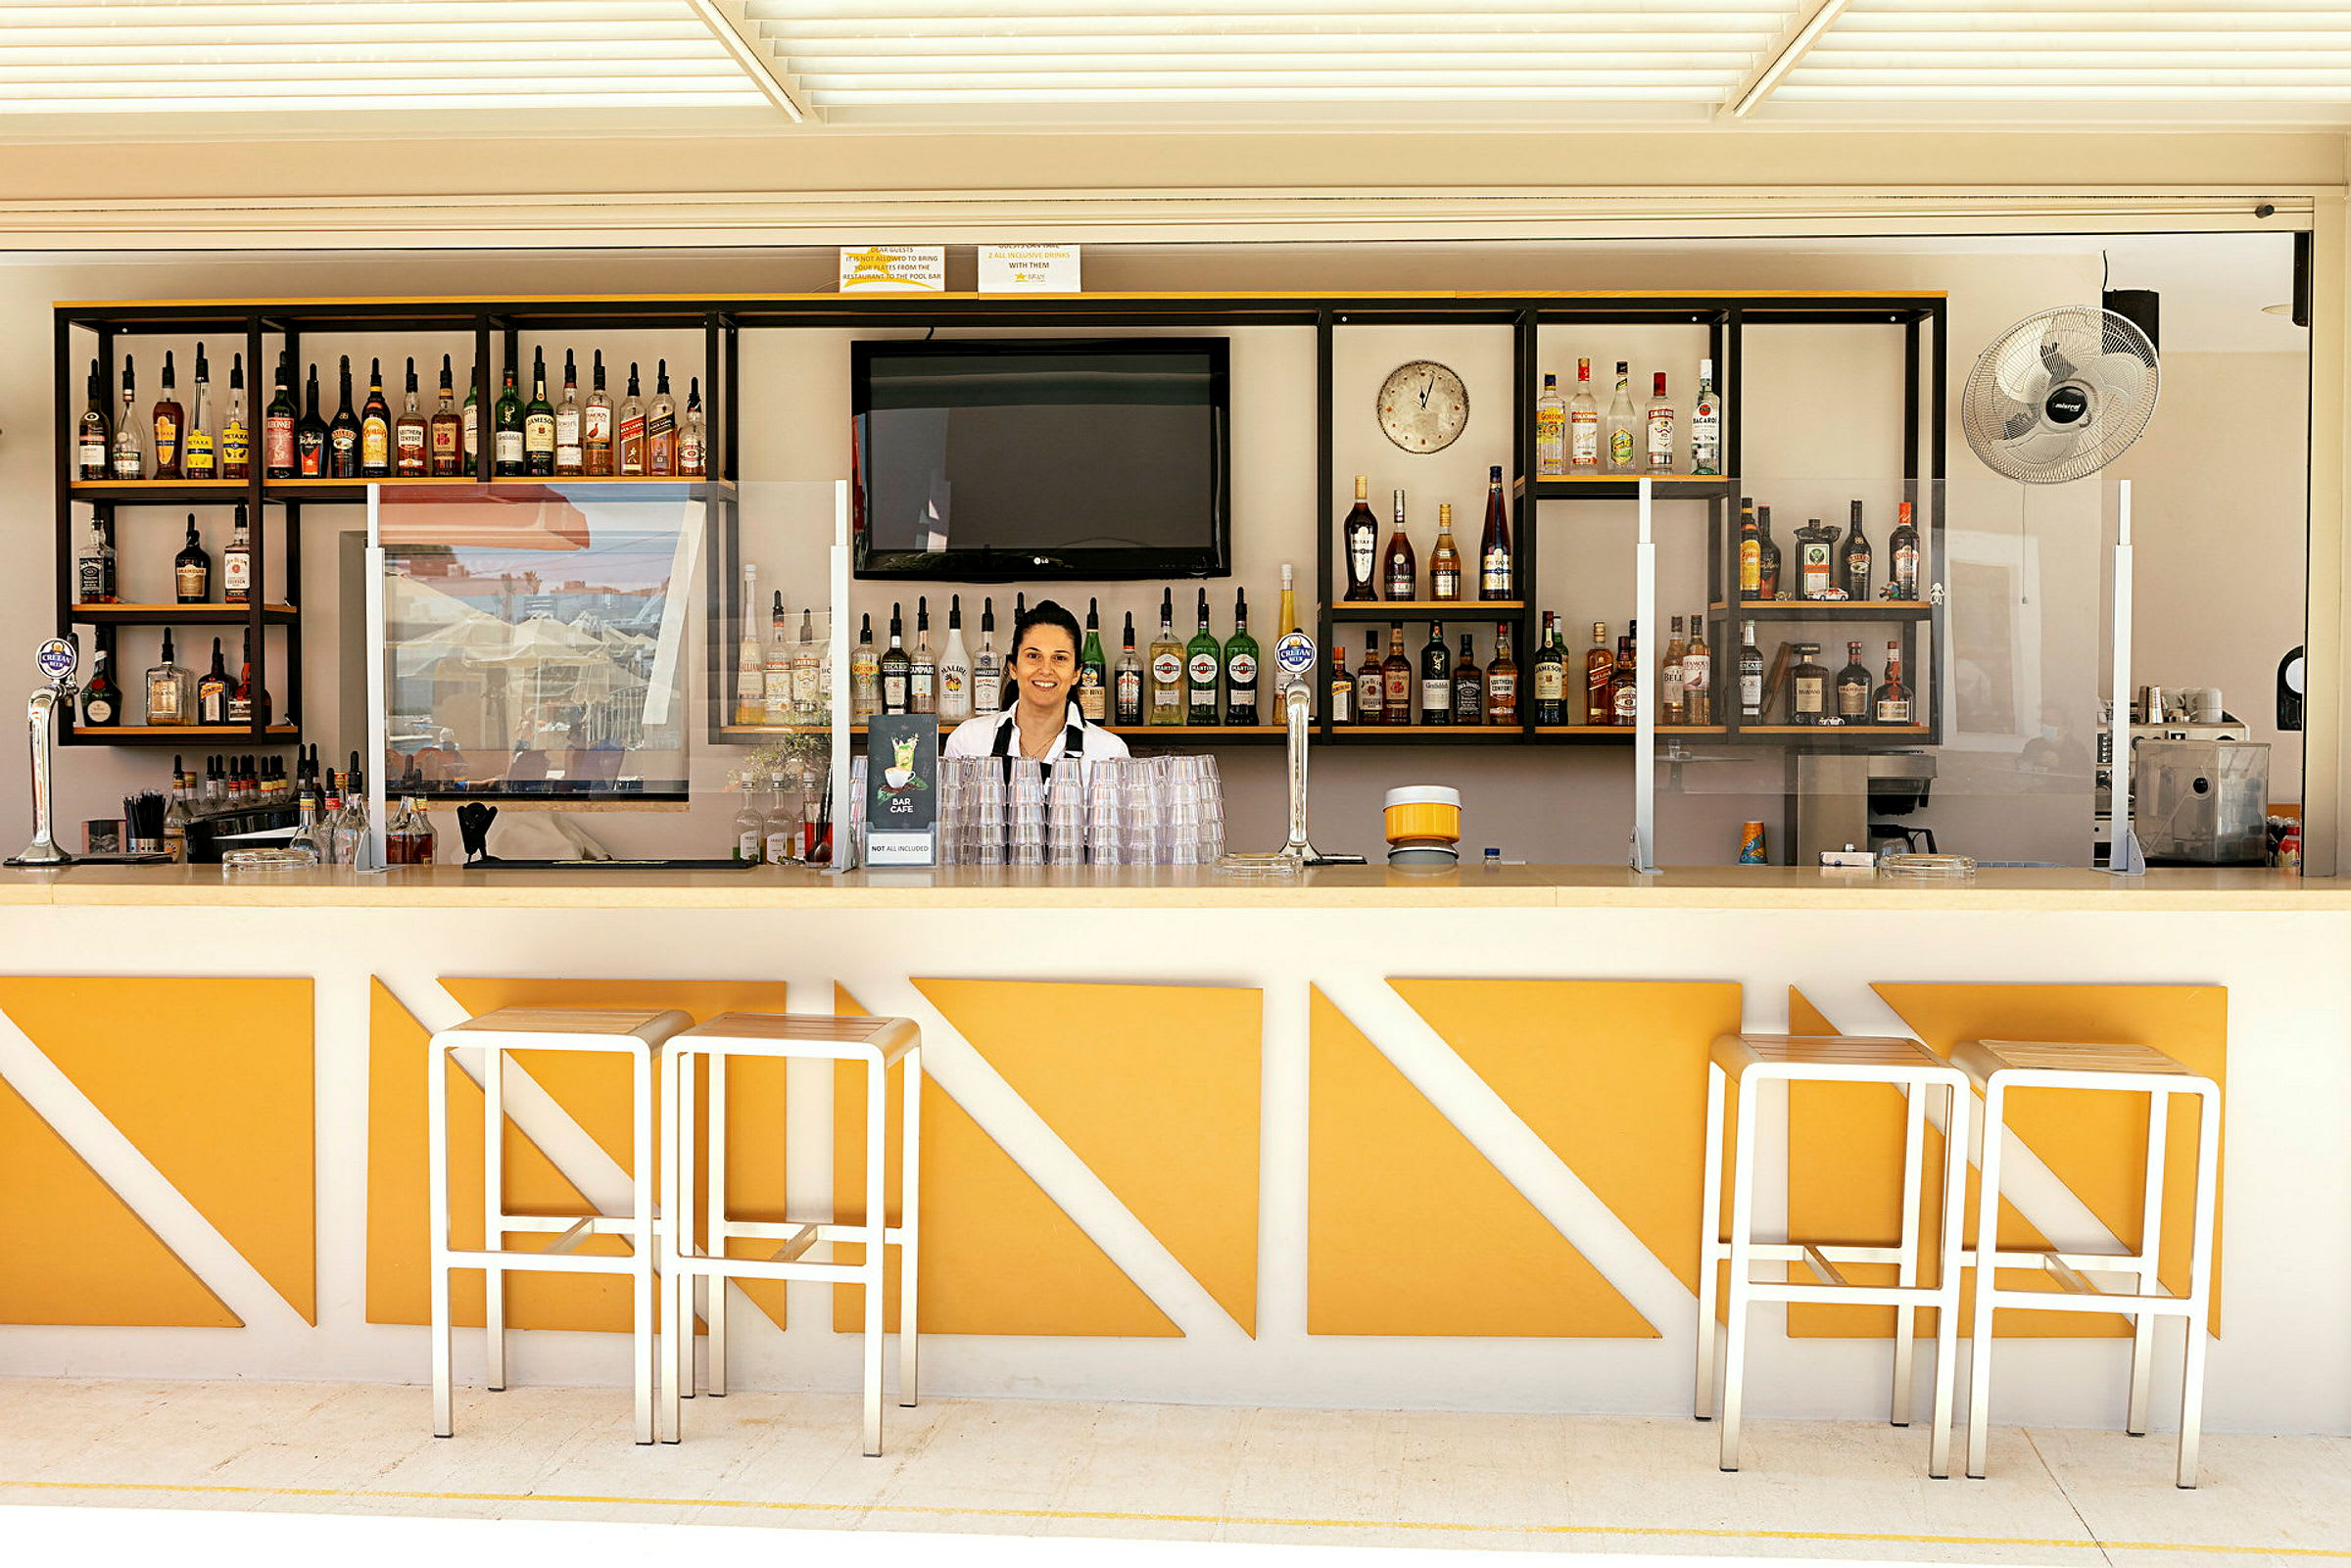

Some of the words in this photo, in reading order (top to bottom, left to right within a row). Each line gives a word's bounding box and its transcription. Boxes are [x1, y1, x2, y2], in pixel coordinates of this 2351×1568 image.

[528, 417, 554, 426] JAMESON
[42, 654, 72, 663] CRETAN
[1281, 650, 1312, 658] CRETAN
[941, 665, 967, 676] MALIBU
[1535, 665, 1561, 673] JAMESON
